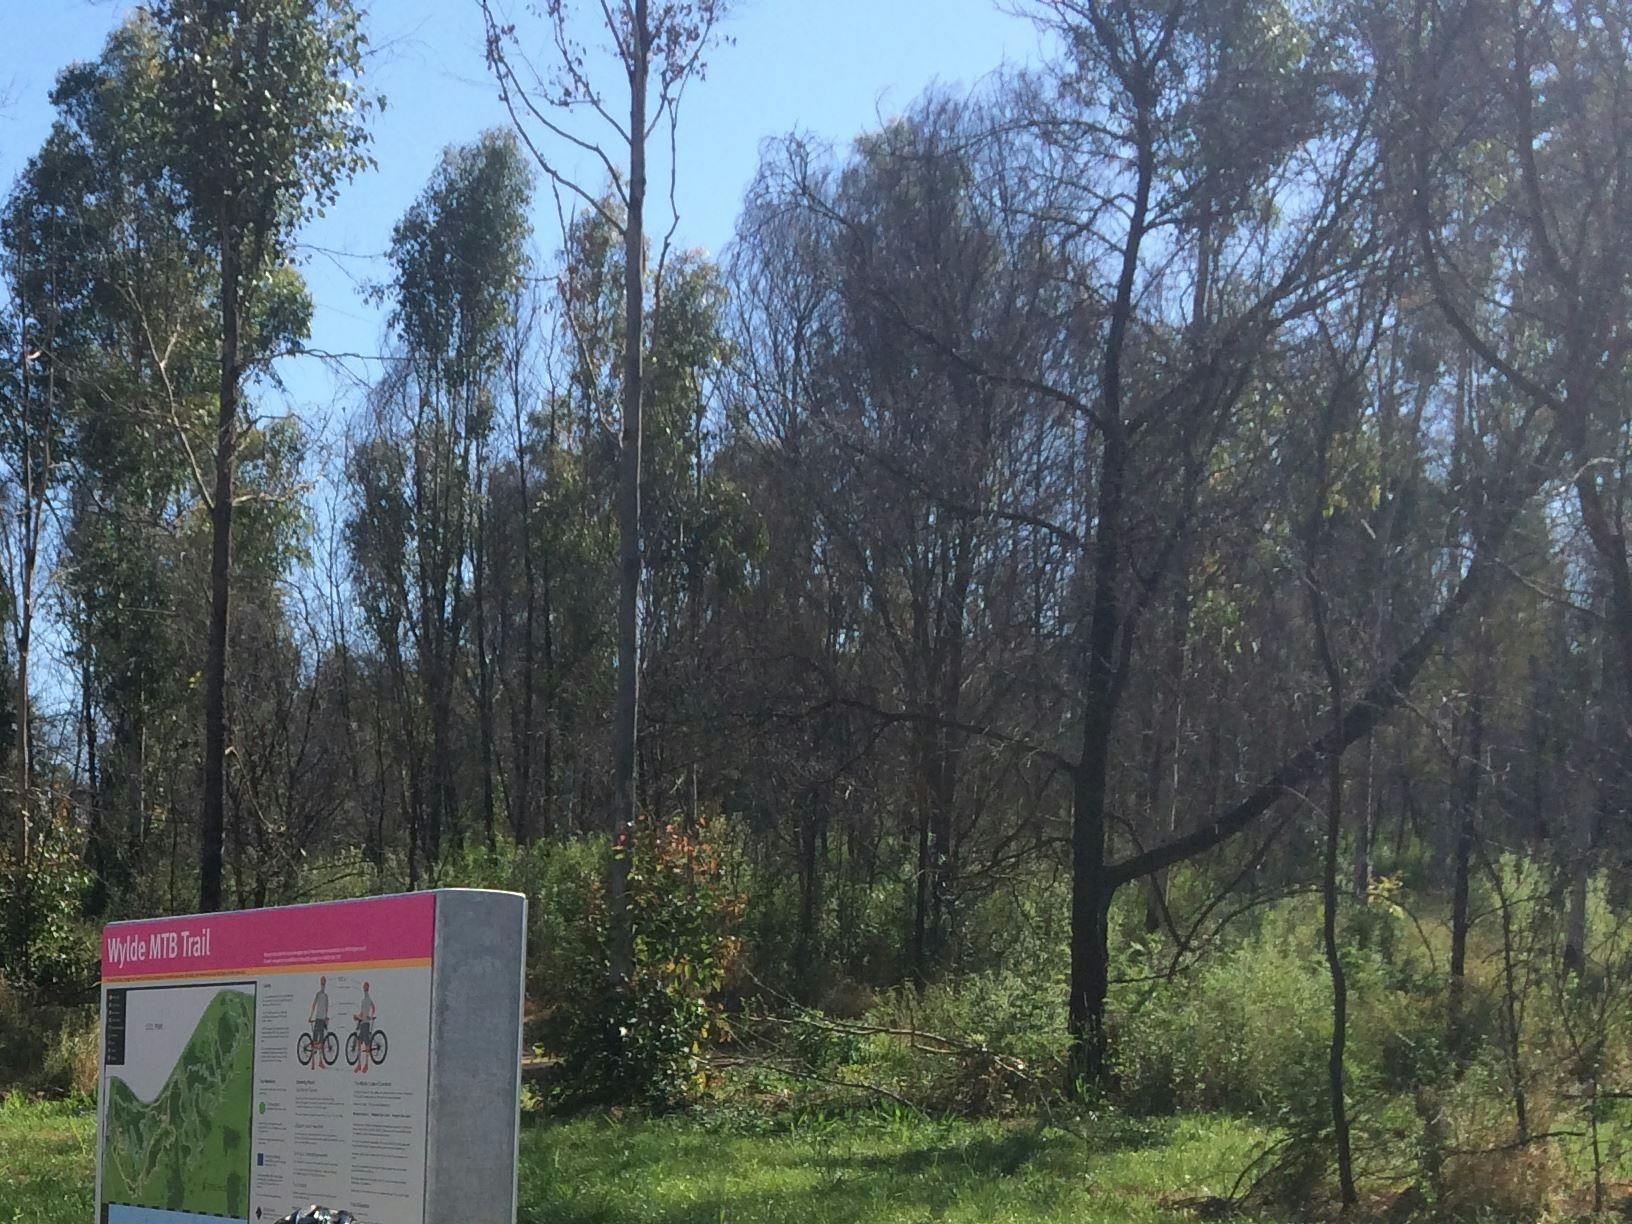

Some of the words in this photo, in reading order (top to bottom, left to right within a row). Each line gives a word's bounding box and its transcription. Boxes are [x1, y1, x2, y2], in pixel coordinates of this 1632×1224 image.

[107, 934, 146, 968] Wylde
[149, 932, 178, 959] MTB
[181, 928, 210, 956] Trail
